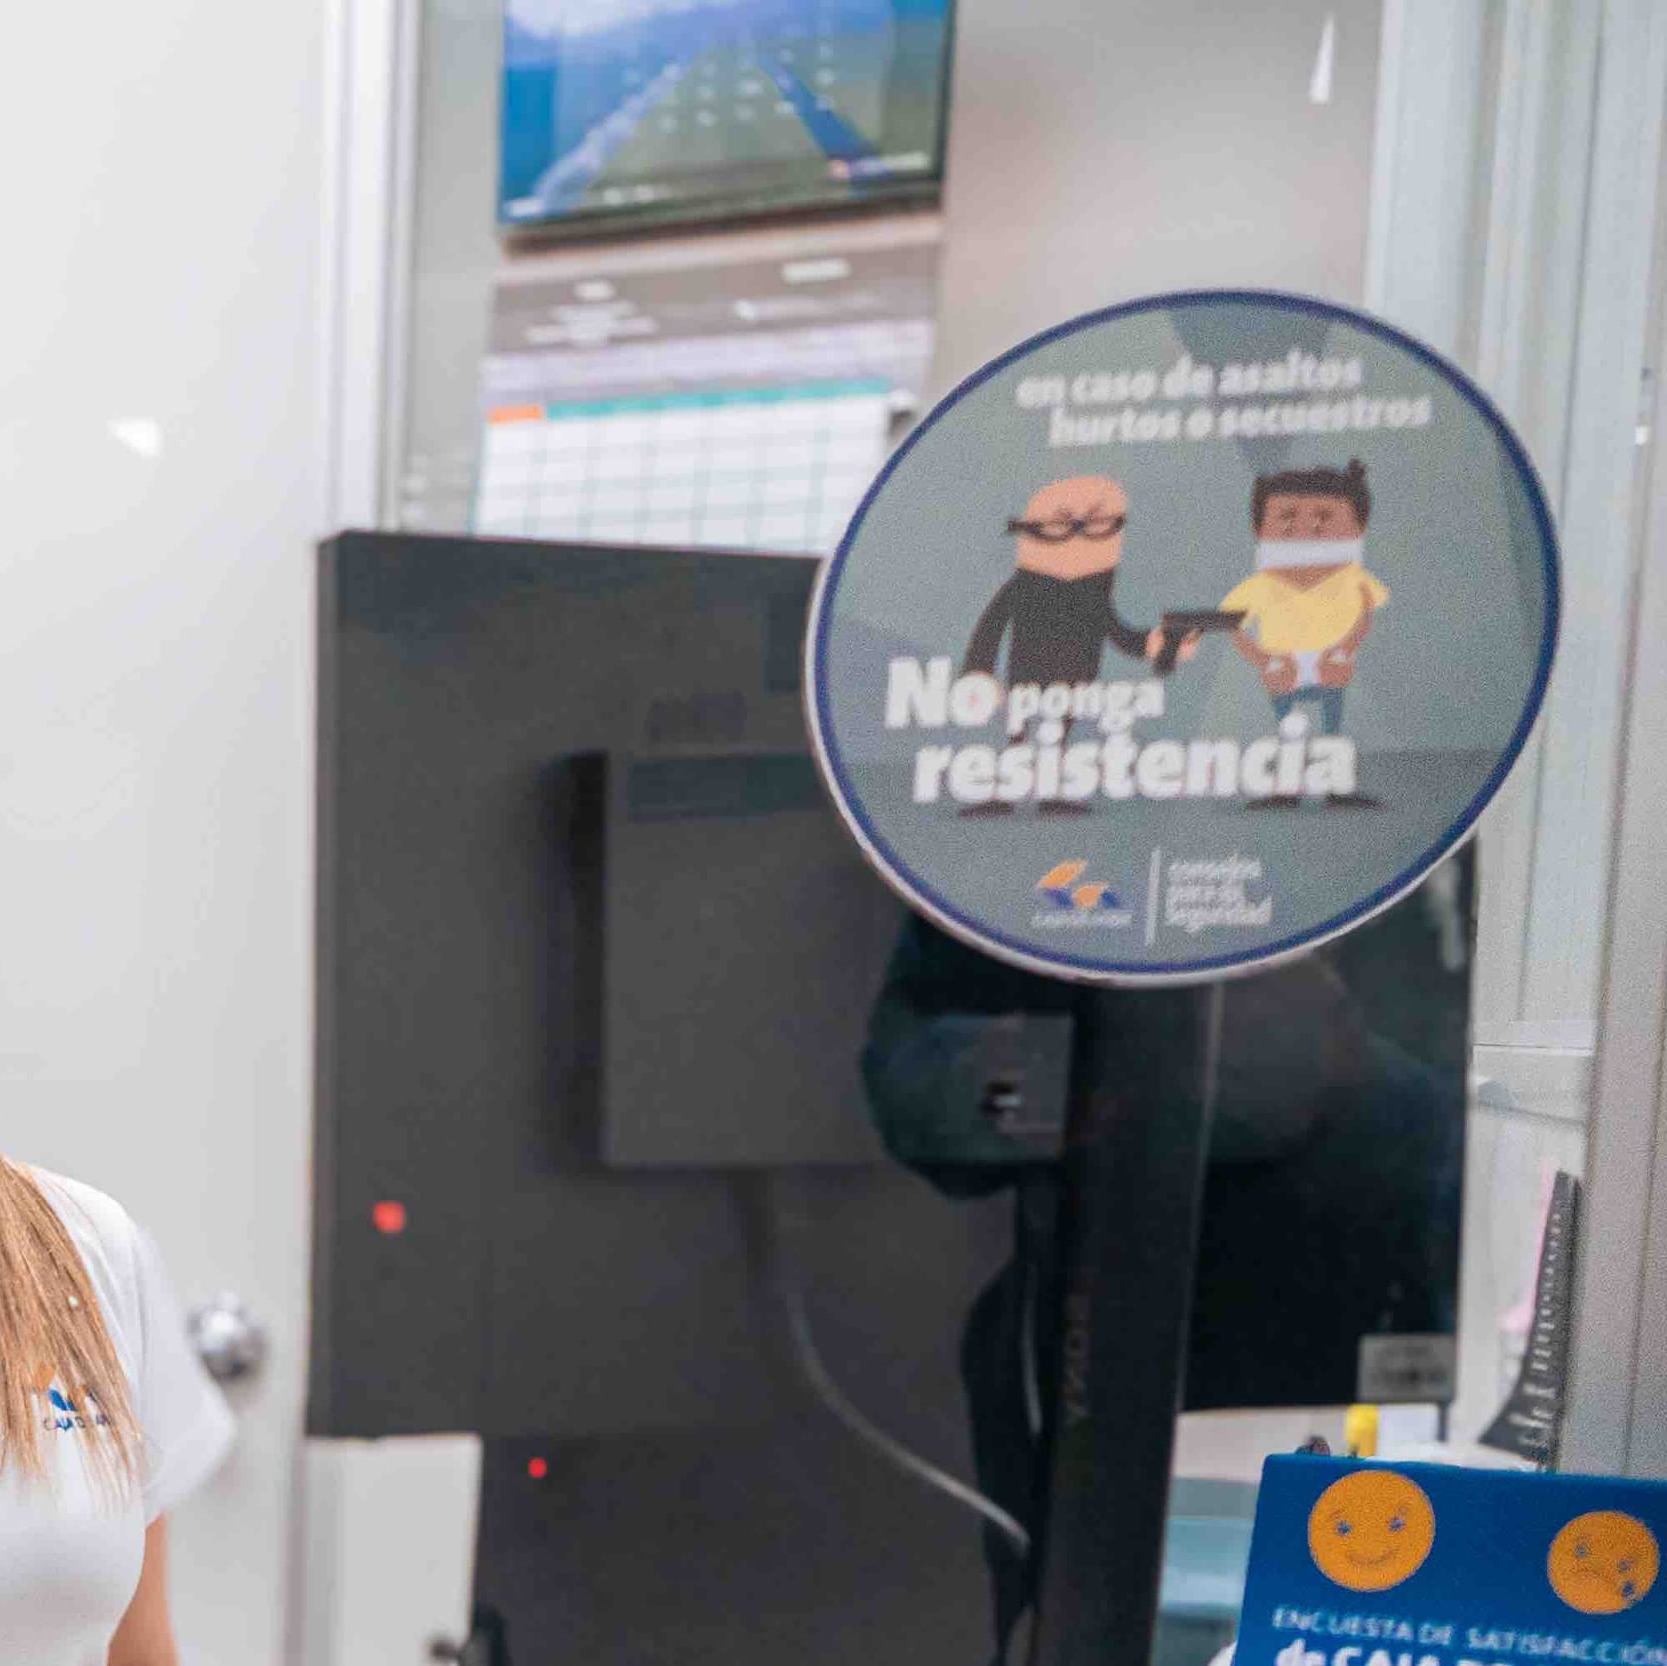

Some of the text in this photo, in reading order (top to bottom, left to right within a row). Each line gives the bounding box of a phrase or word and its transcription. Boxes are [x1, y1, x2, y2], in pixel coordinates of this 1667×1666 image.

[1070, 371, 1158, 405] caso
[1162, 353, 1214, 398] de
[1218, 348, 1362, 395] asaltos
[1048, 406, 1181, 447] hurtos
[1218, 397, 1433, 438] secuestros
[884, 654, 1166, 738] No ponga
[912, 707, 1357, 802] resistencia
[1272, 1606, 1415, 1643] ENCUESTA
[1418, 1620, 1454, 1646] DE
